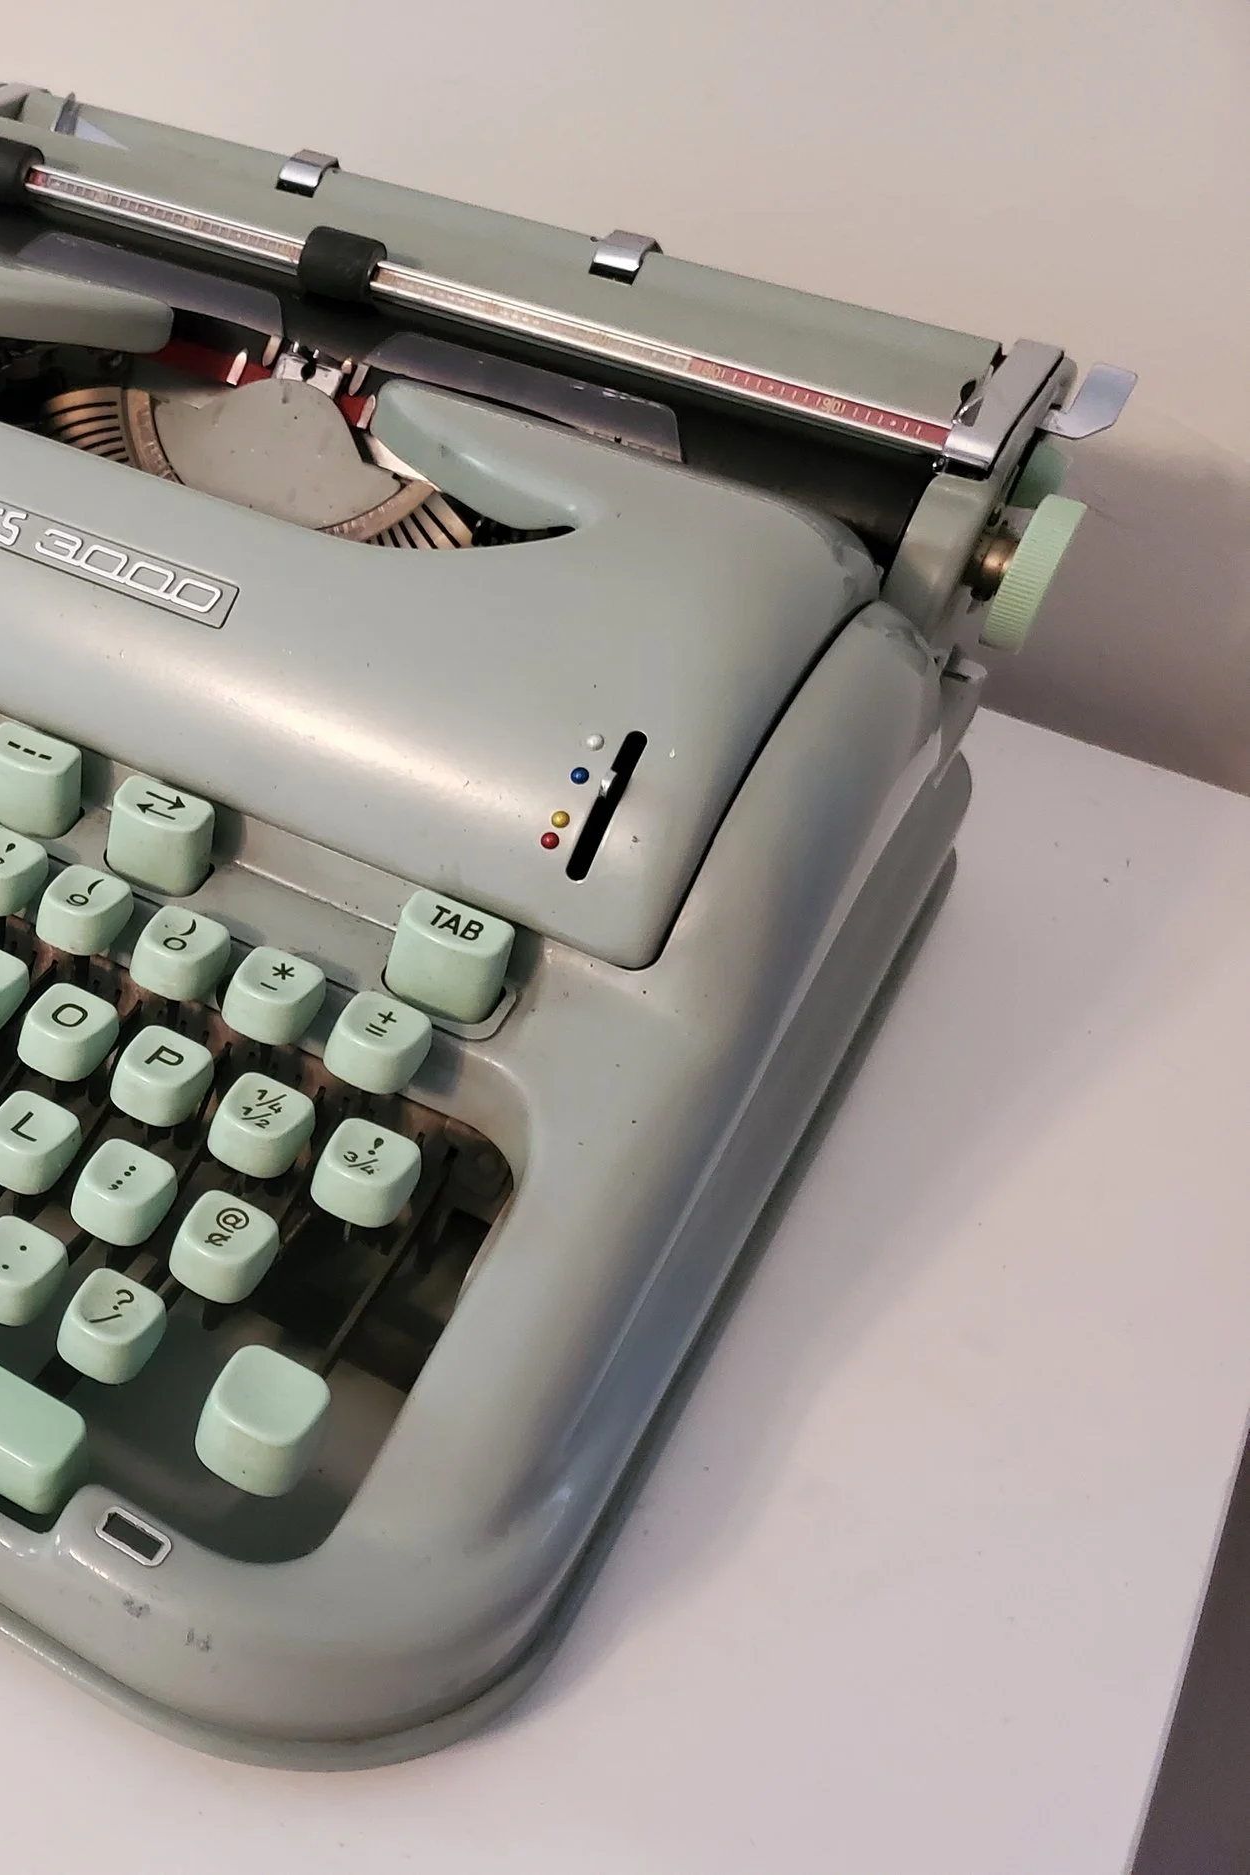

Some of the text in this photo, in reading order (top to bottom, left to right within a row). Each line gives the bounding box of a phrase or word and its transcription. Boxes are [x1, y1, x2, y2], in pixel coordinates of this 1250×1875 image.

[34, 528, 224, 614] 3000
[66, 894, 89, 906] 9
[430, 905, 484, 940] TAB
[163, 937, 187, 950] 0
[52, 1004, 88, 1027] O
[145, 1045, 184, 1066] P
[10, 1112, 37, 1141] L
[216, 1208, 249, 1233] @
[113, 1289, 134, 1310] ?
